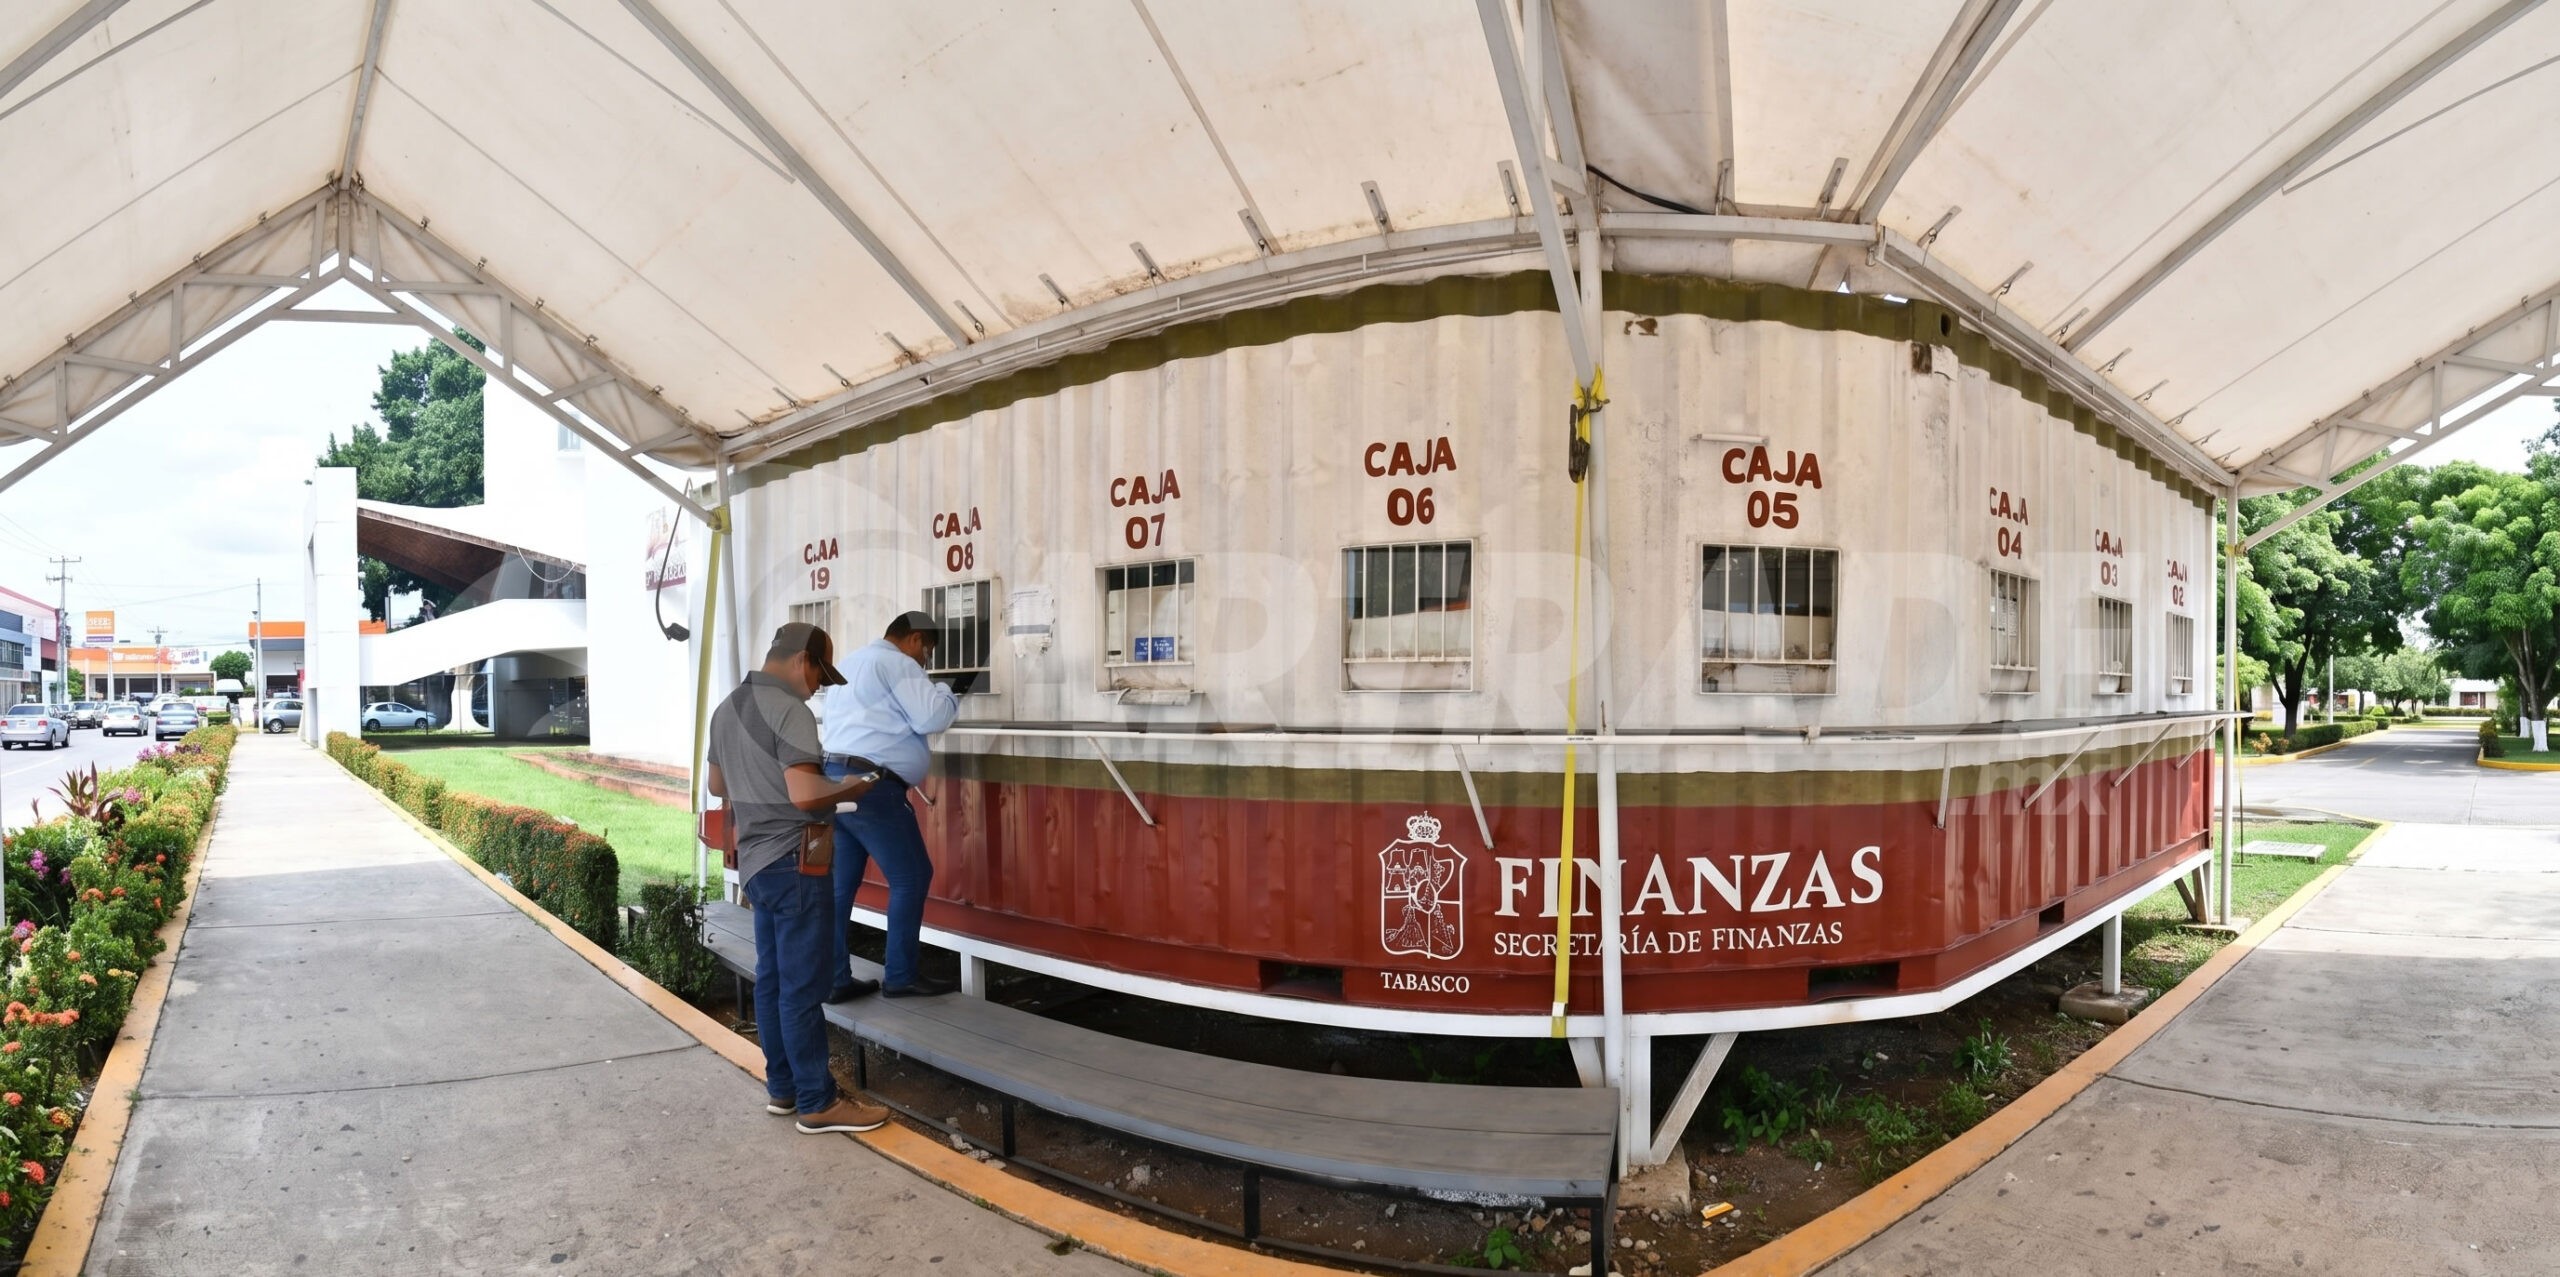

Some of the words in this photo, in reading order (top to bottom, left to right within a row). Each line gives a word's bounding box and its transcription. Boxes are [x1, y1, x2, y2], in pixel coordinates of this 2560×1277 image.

[1365, 436, 1457, 477] CAJA
[1721, 445, 1823, 490] CAJA
[1110, 469, 1181, 508] CAJA
[932, 506, 982, 539] CAJA
[1386, 486, 1435, 527] 06
[1746, 490, 1800, 530] 05
[1989, 486, 2029, 526] CAJA
[1125, 512, 1166, 550] 07
[1997, 526, 2022, 560] 04
[804, 537, 839, 565] CAA
[946, 542, 974, 573] 08
[810, 567, 830, 591] 19
[2101, 560, 2118, 588] 03
[2172, 584, 2184, 607] 02
[1494, 846, 1884, 918] FINANZAS
[1668, 930, 1701, 954] DE
[1711, 921, 1843, 951] FINANZAS
[1380, 971, 1470, 994] TABASCO
